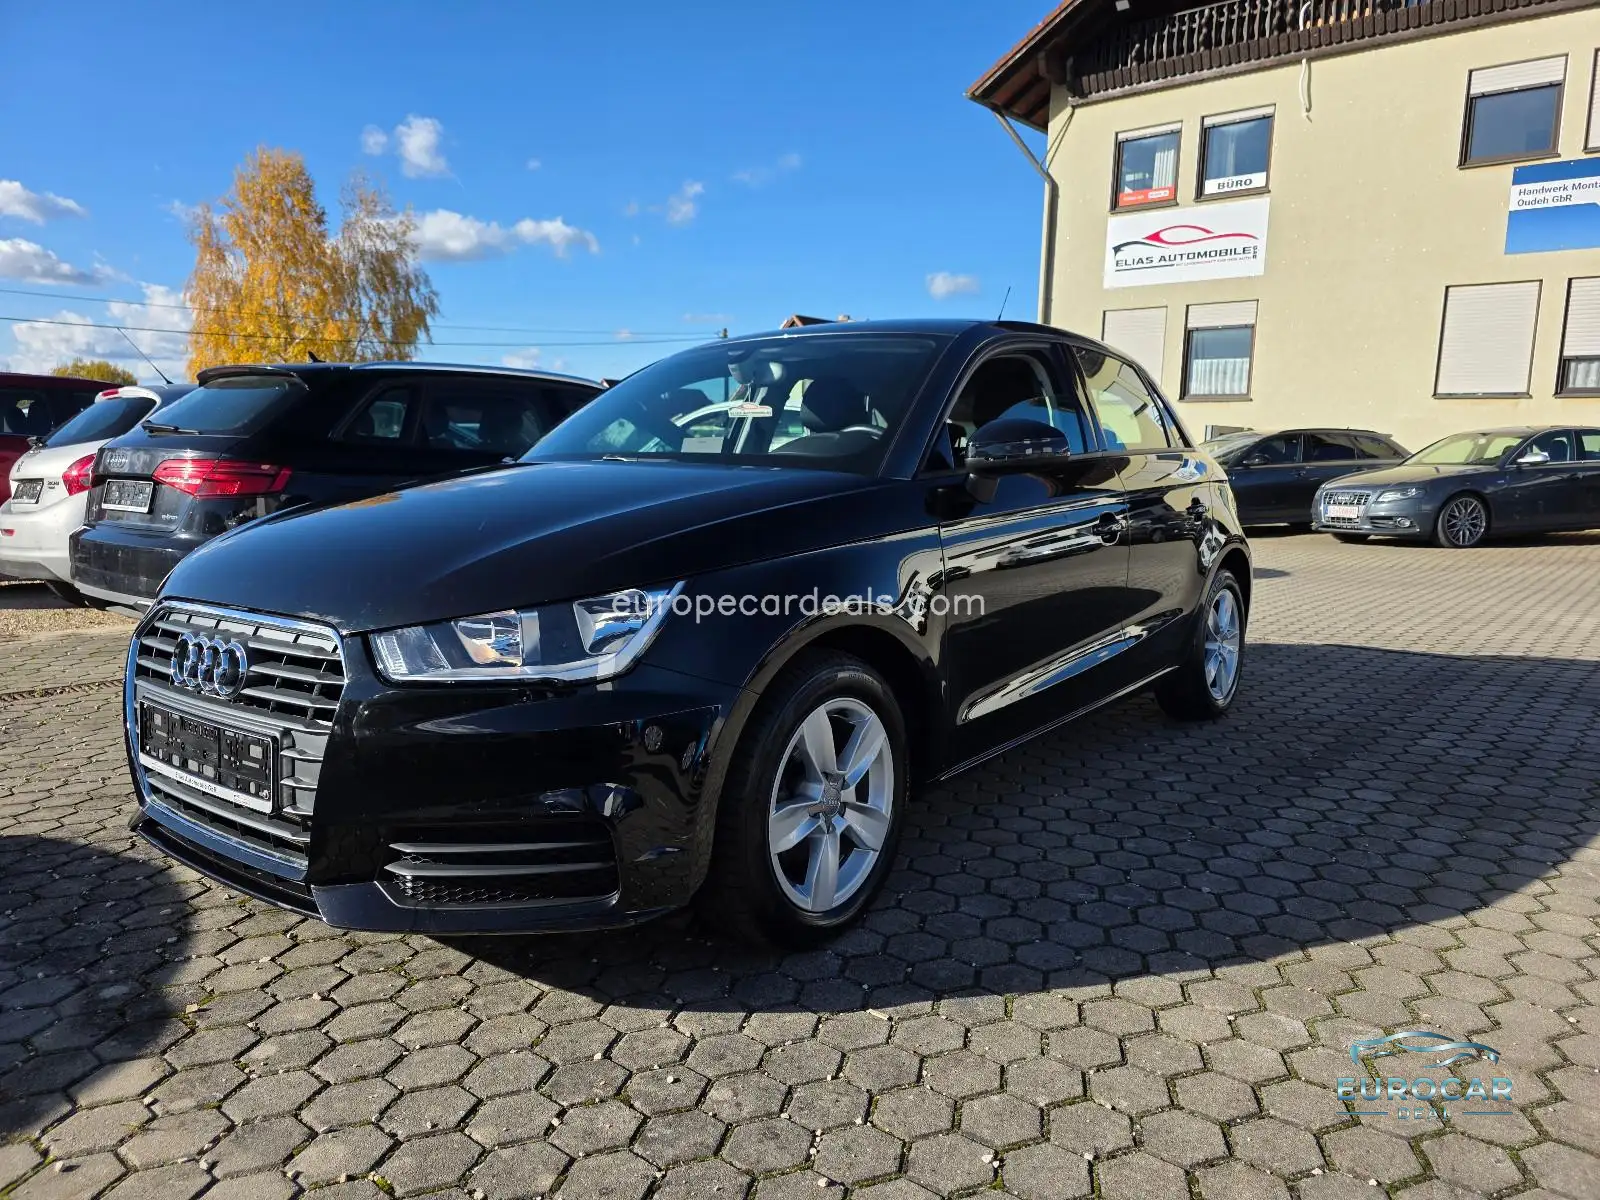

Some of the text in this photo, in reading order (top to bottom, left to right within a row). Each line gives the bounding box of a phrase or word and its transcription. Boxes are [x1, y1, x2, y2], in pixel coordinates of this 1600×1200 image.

[1217, 179, 1252, 190] BÜRO
[1519, 184, 1569, 195] Handwerk
[1517, 194, 1573, 207] Oudeh GbR
[1115, 256, 1154, 268] ELIAS
[1158, 246, 1252, 263] AUTOMOBILE
